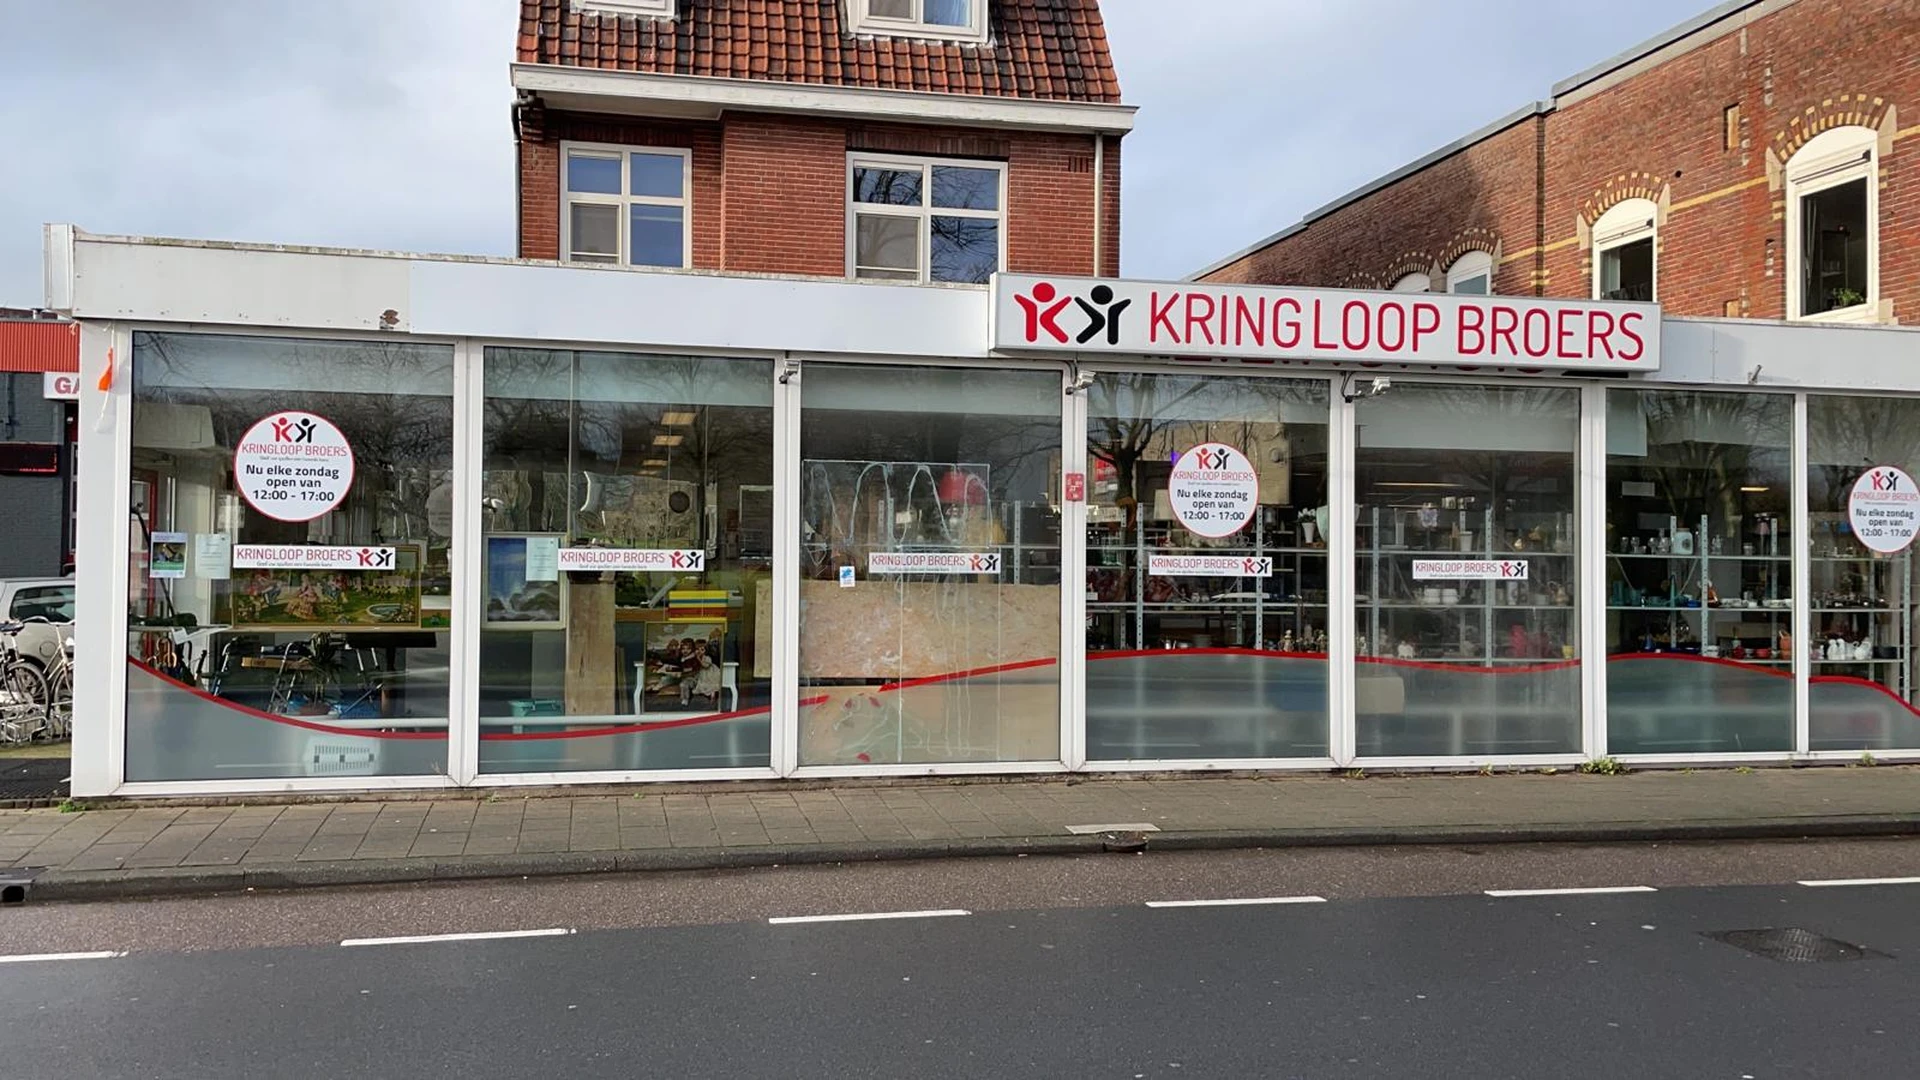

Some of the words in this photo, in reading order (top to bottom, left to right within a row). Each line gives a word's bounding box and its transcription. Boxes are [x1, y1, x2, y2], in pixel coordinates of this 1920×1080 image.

[1458, 304, 1645, 361] BROERS
[242, 443, 303, 455] KRINGLOOP
[305, 445, 347, 457] BROERS
[246, 465, 263, 475] Nu
[267, 465, 292, 475] elke
[295, 466, 340, 479] zondag
[1173, 471, 1220, 480] KRINGLOOP
[1222, 471, 1254, 481] BROERS
[266, 478, 296, 488] open
[300, 479, 321, 487] van
[253, 490, 287, 500] 12:00
[301, 491, 334, 501] 17:00
[1177, 489, 1190, 498] Nu
[1193, 490, 1212, 498] elke
[1214, 490, 1248, 501] zondag
[1192, 501, 1215, 510] open
[1183, 511, 1209, 520] 12:00
[1219, 512, 1245, 520] 17:00
[1886, 510, 1914, 519] zondag
[1868, 519, 1887, 527] open
[1891, 529, 1911, 537] 17:00
[236, 548, 303, 560] KRINGLOOP
[306, 549, 352, 561] BROERS
[561, 552, 621, 562] KRINGLOOP
[623, 552, 665, 563] BROERS
[871, 555, 925, 566] KRINGLOOP
[928, 555, 966, 566] BROERS
[1152, 558, 1202, 568] KRINGLOOP
[1204, 558, 1238, 569] BROERS
[1415, 562, 1462, 572] KRINGLOOP
[1465, 563, 1497, 572] BROERS
